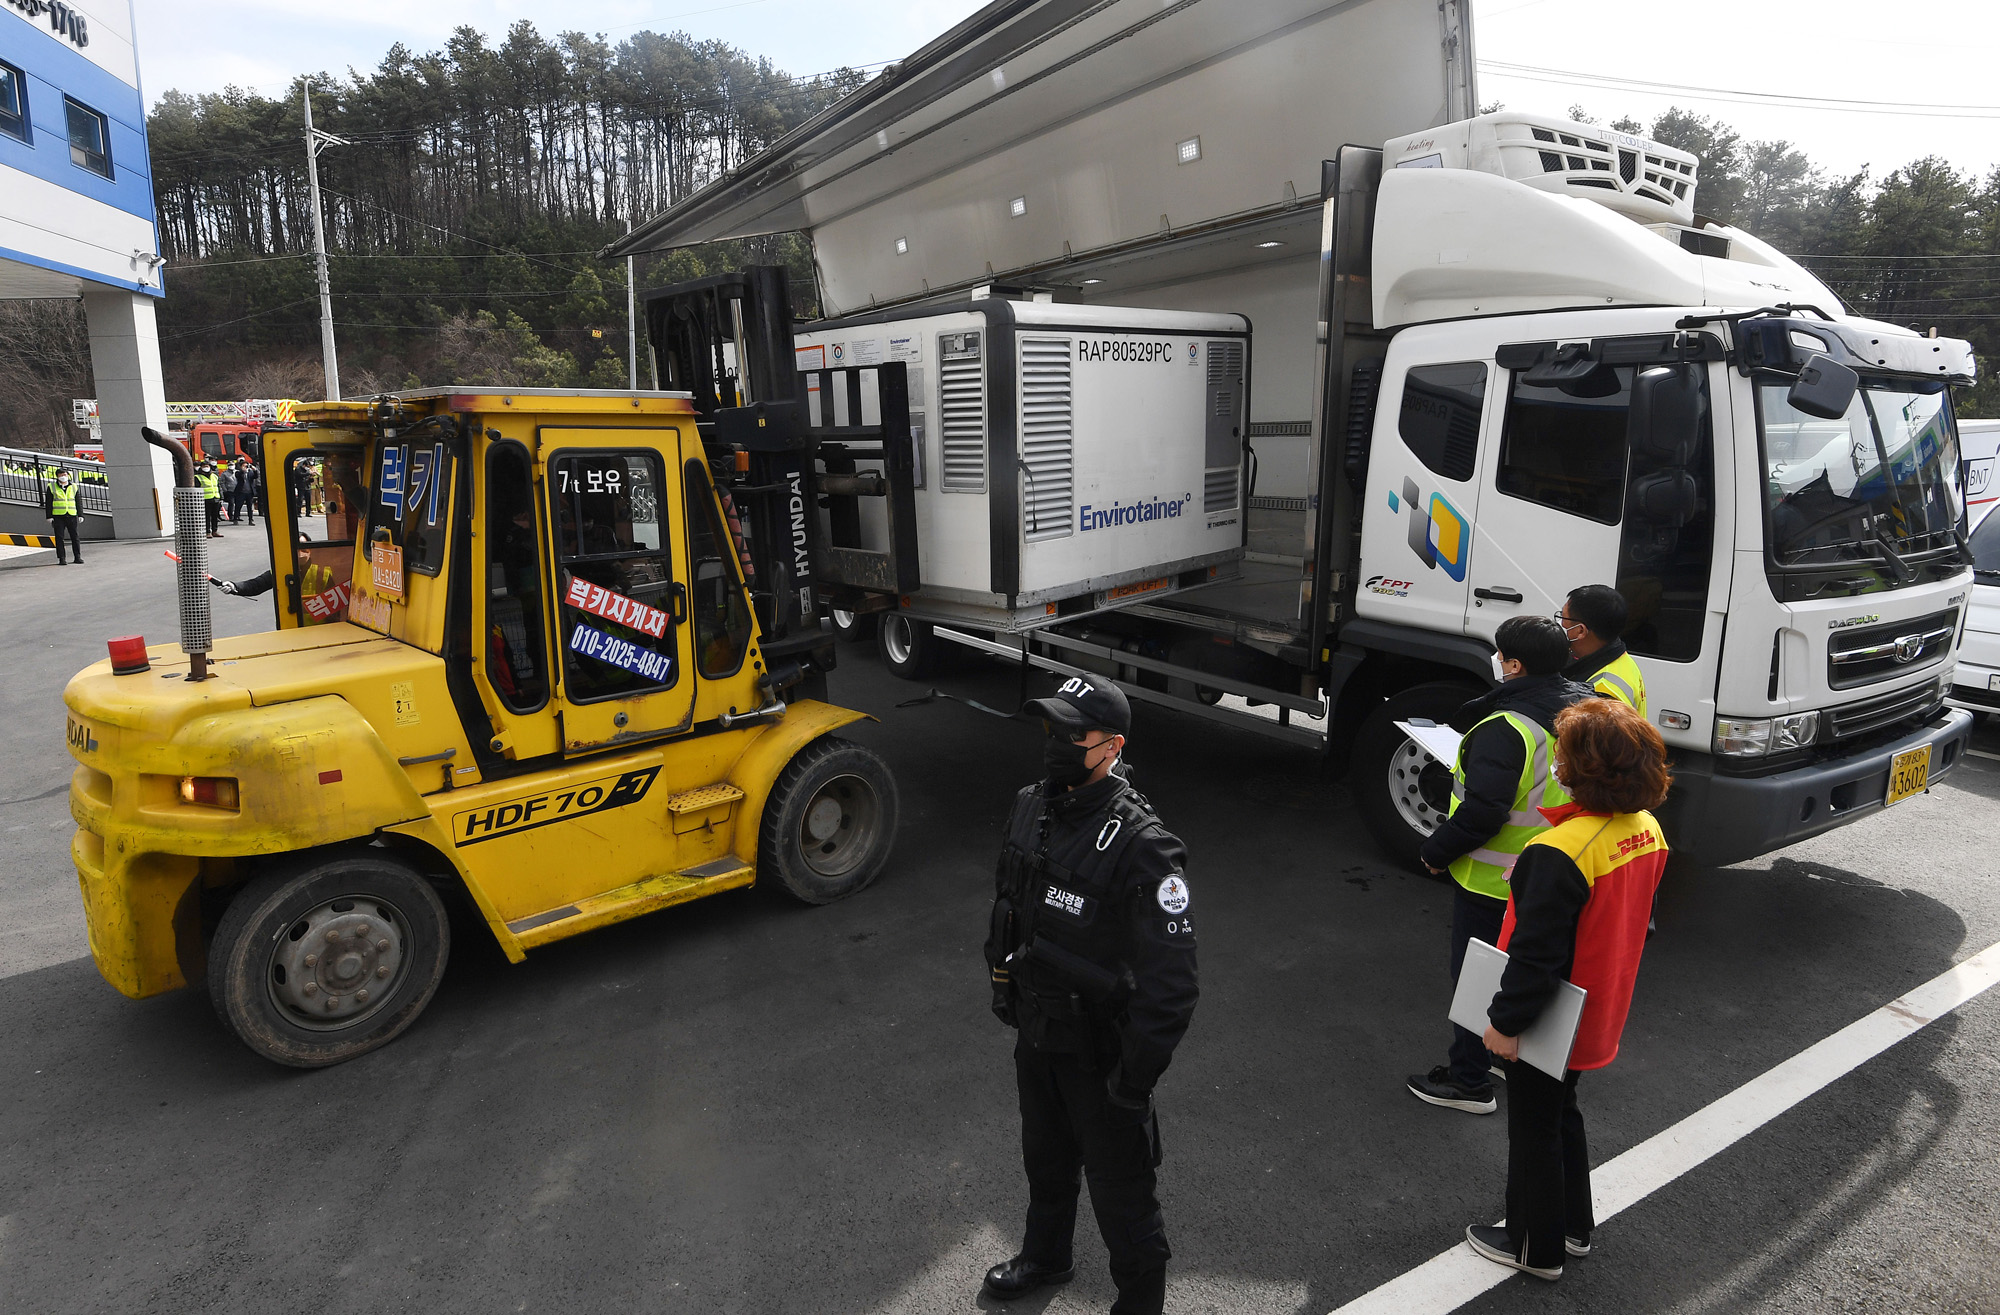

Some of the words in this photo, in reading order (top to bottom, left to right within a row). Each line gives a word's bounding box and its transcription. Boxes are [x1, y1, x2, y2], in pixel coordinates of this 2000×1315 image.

[7, 0, 89, 48] -1718
[1404, 139, 1435, 152] heating
[1079, 340, 1172, 362] RAP80529PC
[380, 442, 444, 527] 럭키
[586, 469, 622, 494] 보유
[1969, 468, 1989, 486] BNT
[786, 471, 810, 577] HYUNDAI
[1080, 495, 1185, 531] Envirotainer
[1141, 580, 1159, 592] LIFT
[1381, 579, 1414, 589] FPT
[569, 578, 665, 637] 럭키지게차
[1828, 614, 1880, 629] DAEWOO
[571, 625, 671, 682] 010-2025-4847
[465, 796, 549, 837] HDF
[1616, 829, 1655, 857] DHL
[1046, 885, 1085, 909] 군사경찰
[1065, 904, 1081, 916] POLICE
